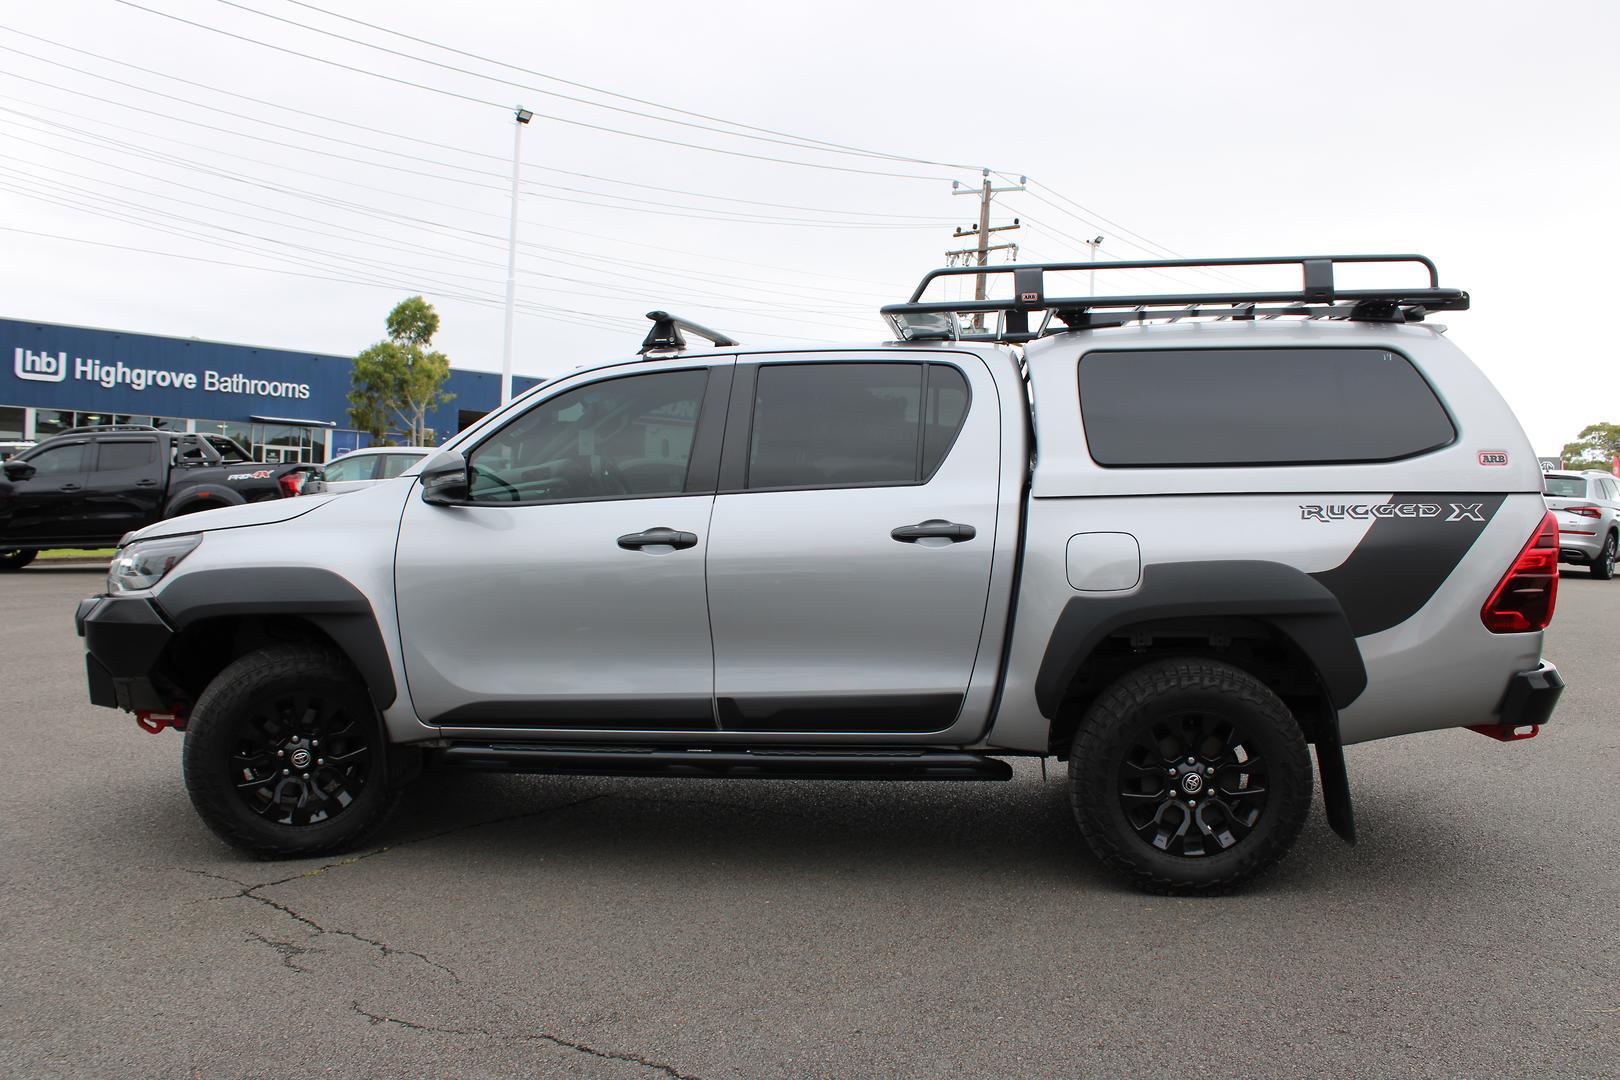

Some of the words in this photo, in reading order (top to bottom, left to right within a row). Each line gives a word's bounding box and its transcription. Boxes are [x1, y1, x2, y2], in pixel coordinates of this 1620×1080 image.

[75, 357, 197, 391] Highgrove
[204, 370, 310, 399] Bathrooms
[1482, 455, 1506, 463] ARB
[1299, 503, 1442, 522] RUGGED
[1445, 503, 1486, 521] X
